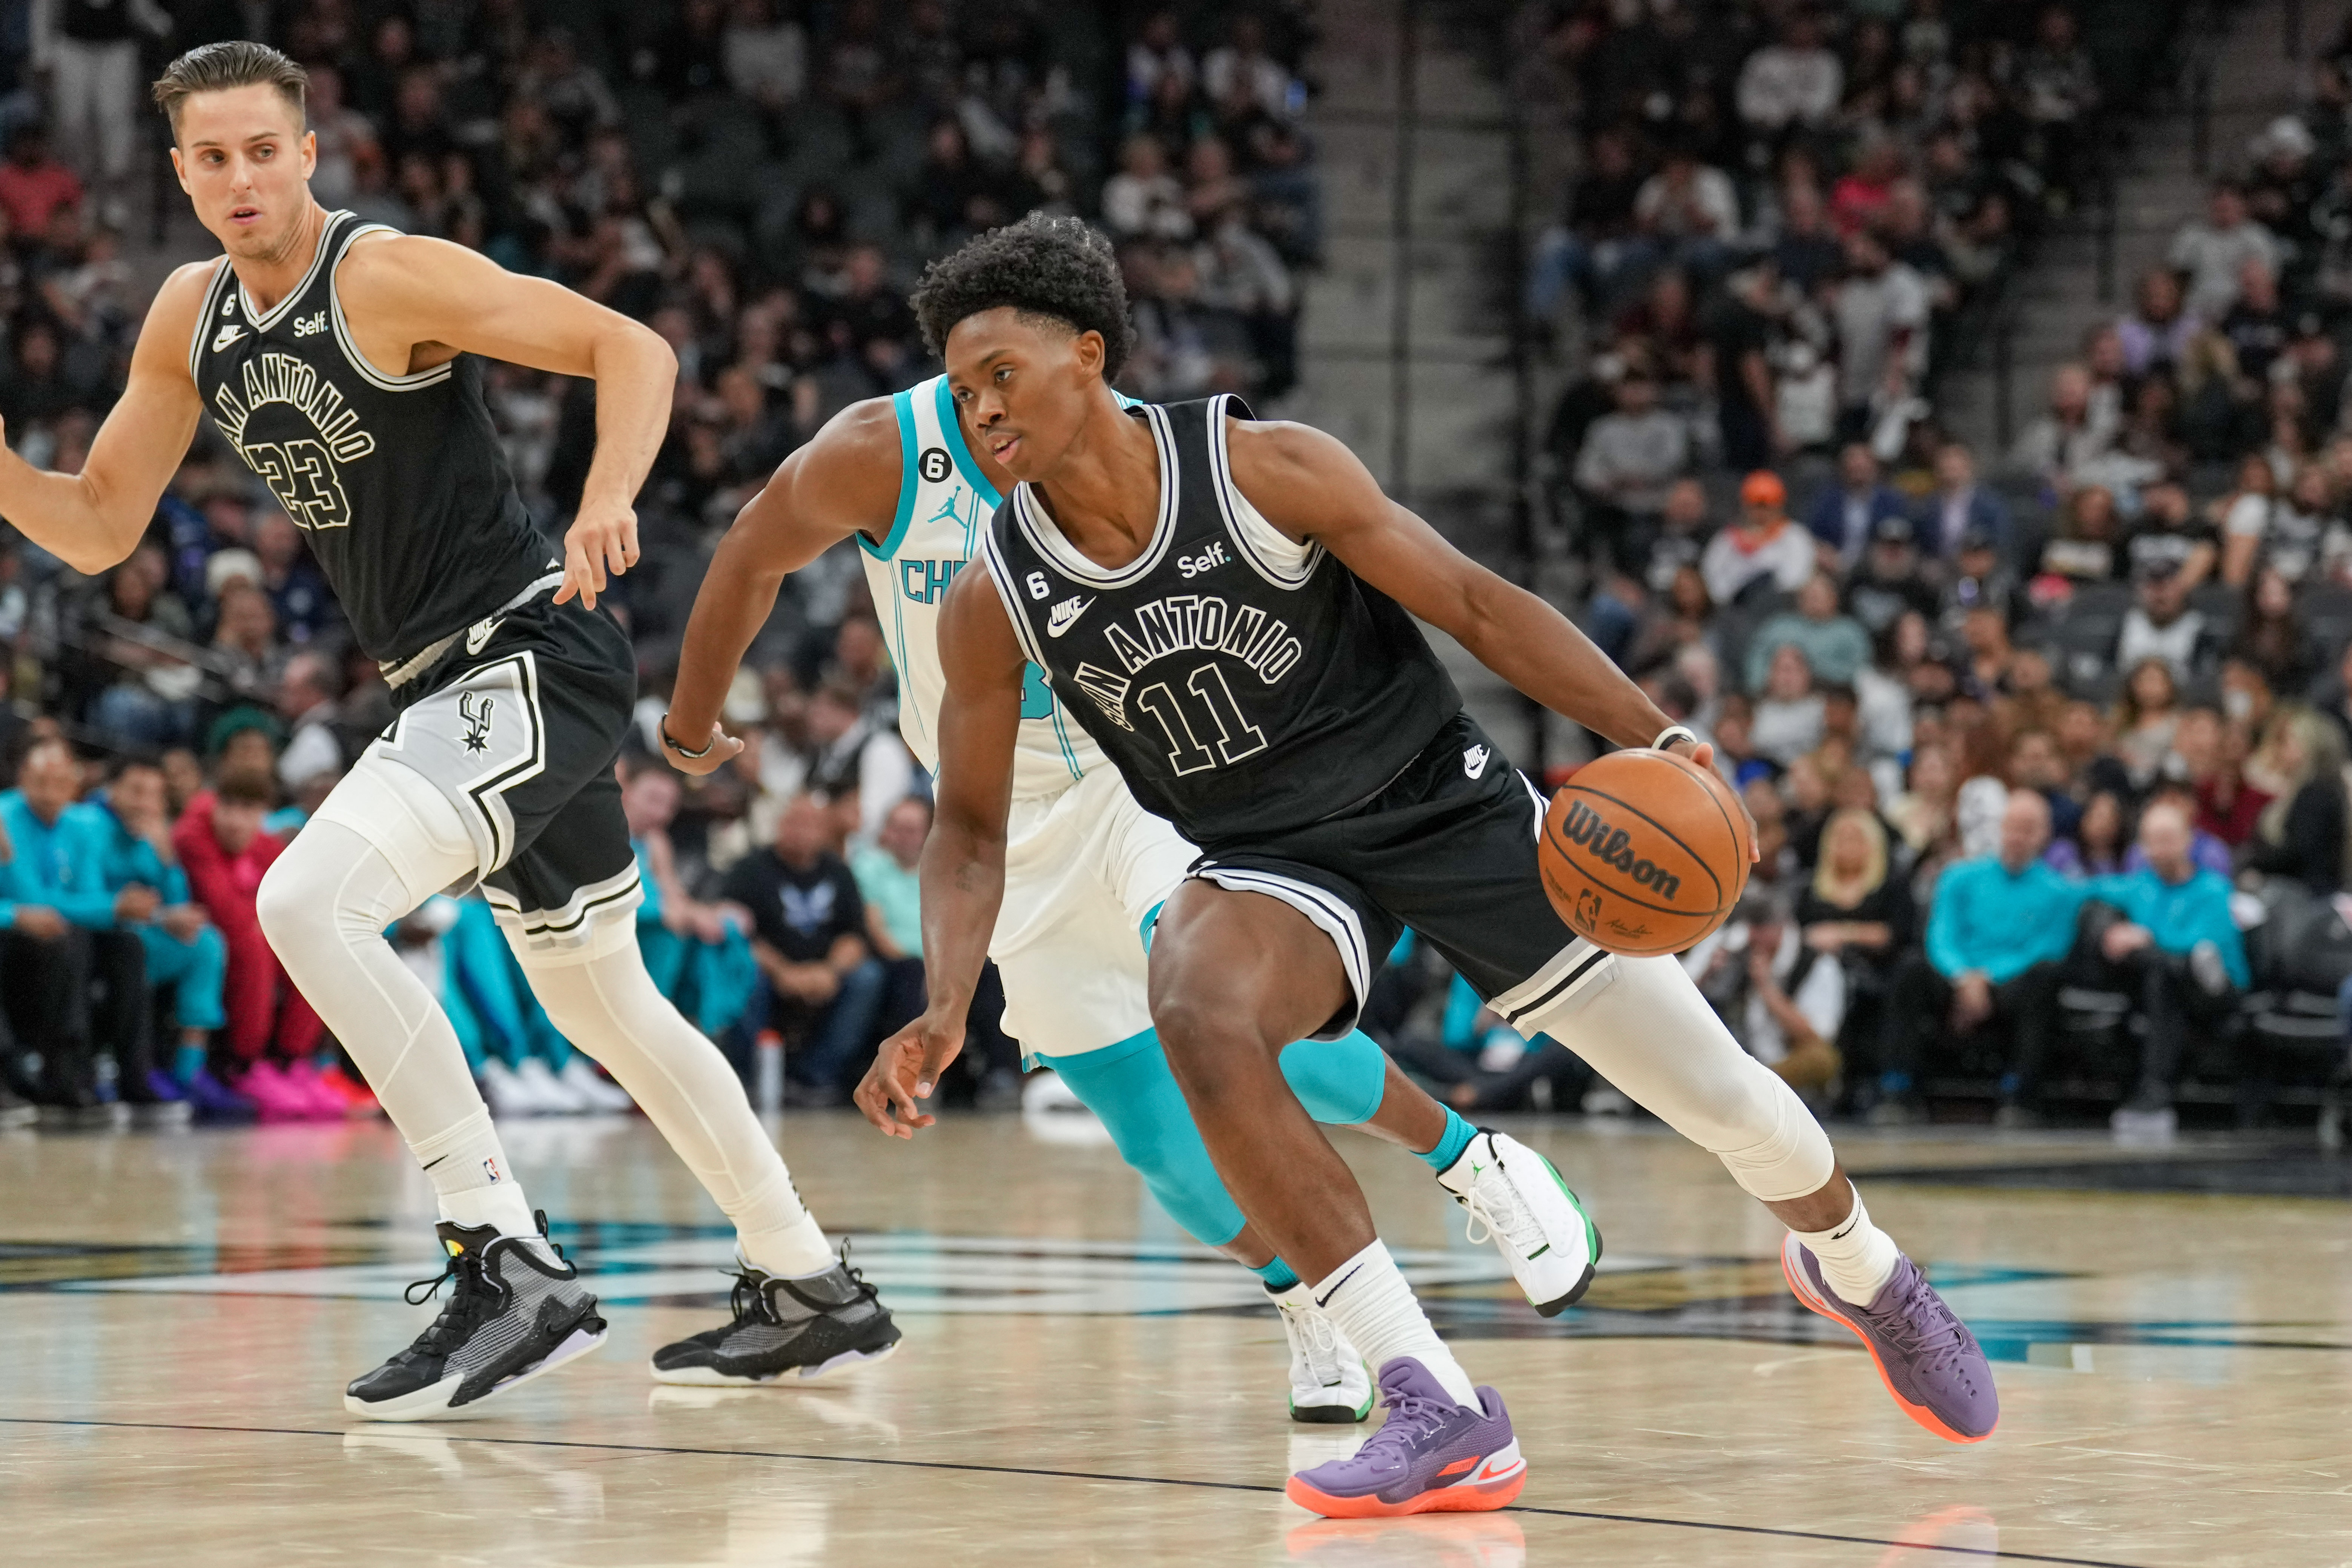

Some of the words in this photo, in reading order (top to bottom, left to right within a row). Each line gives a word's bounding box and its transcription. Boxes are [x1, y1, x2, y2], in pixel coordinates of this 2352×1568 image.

[221, 294, 236, 316] 6
[219, 324, 242, 341] NIKE
[214, 382, 253, 471] AN
[243, 353, 375, 463] ANTONIO
[926, 453, 944, 479] 6
[244, 439, 351, 530] 23
[1026, 571, 1050, 600] 6
[1051, 595, 1081, 625] NIKE
[468, 616, 493, 643] NIKE
[1103, 594, 1302, 685] ANTONIO
[1137, 662, 1268, 777] 11
[1463, 744, 1483, 769] NIKE
[1563, 799, 1681, 901] Wilson
